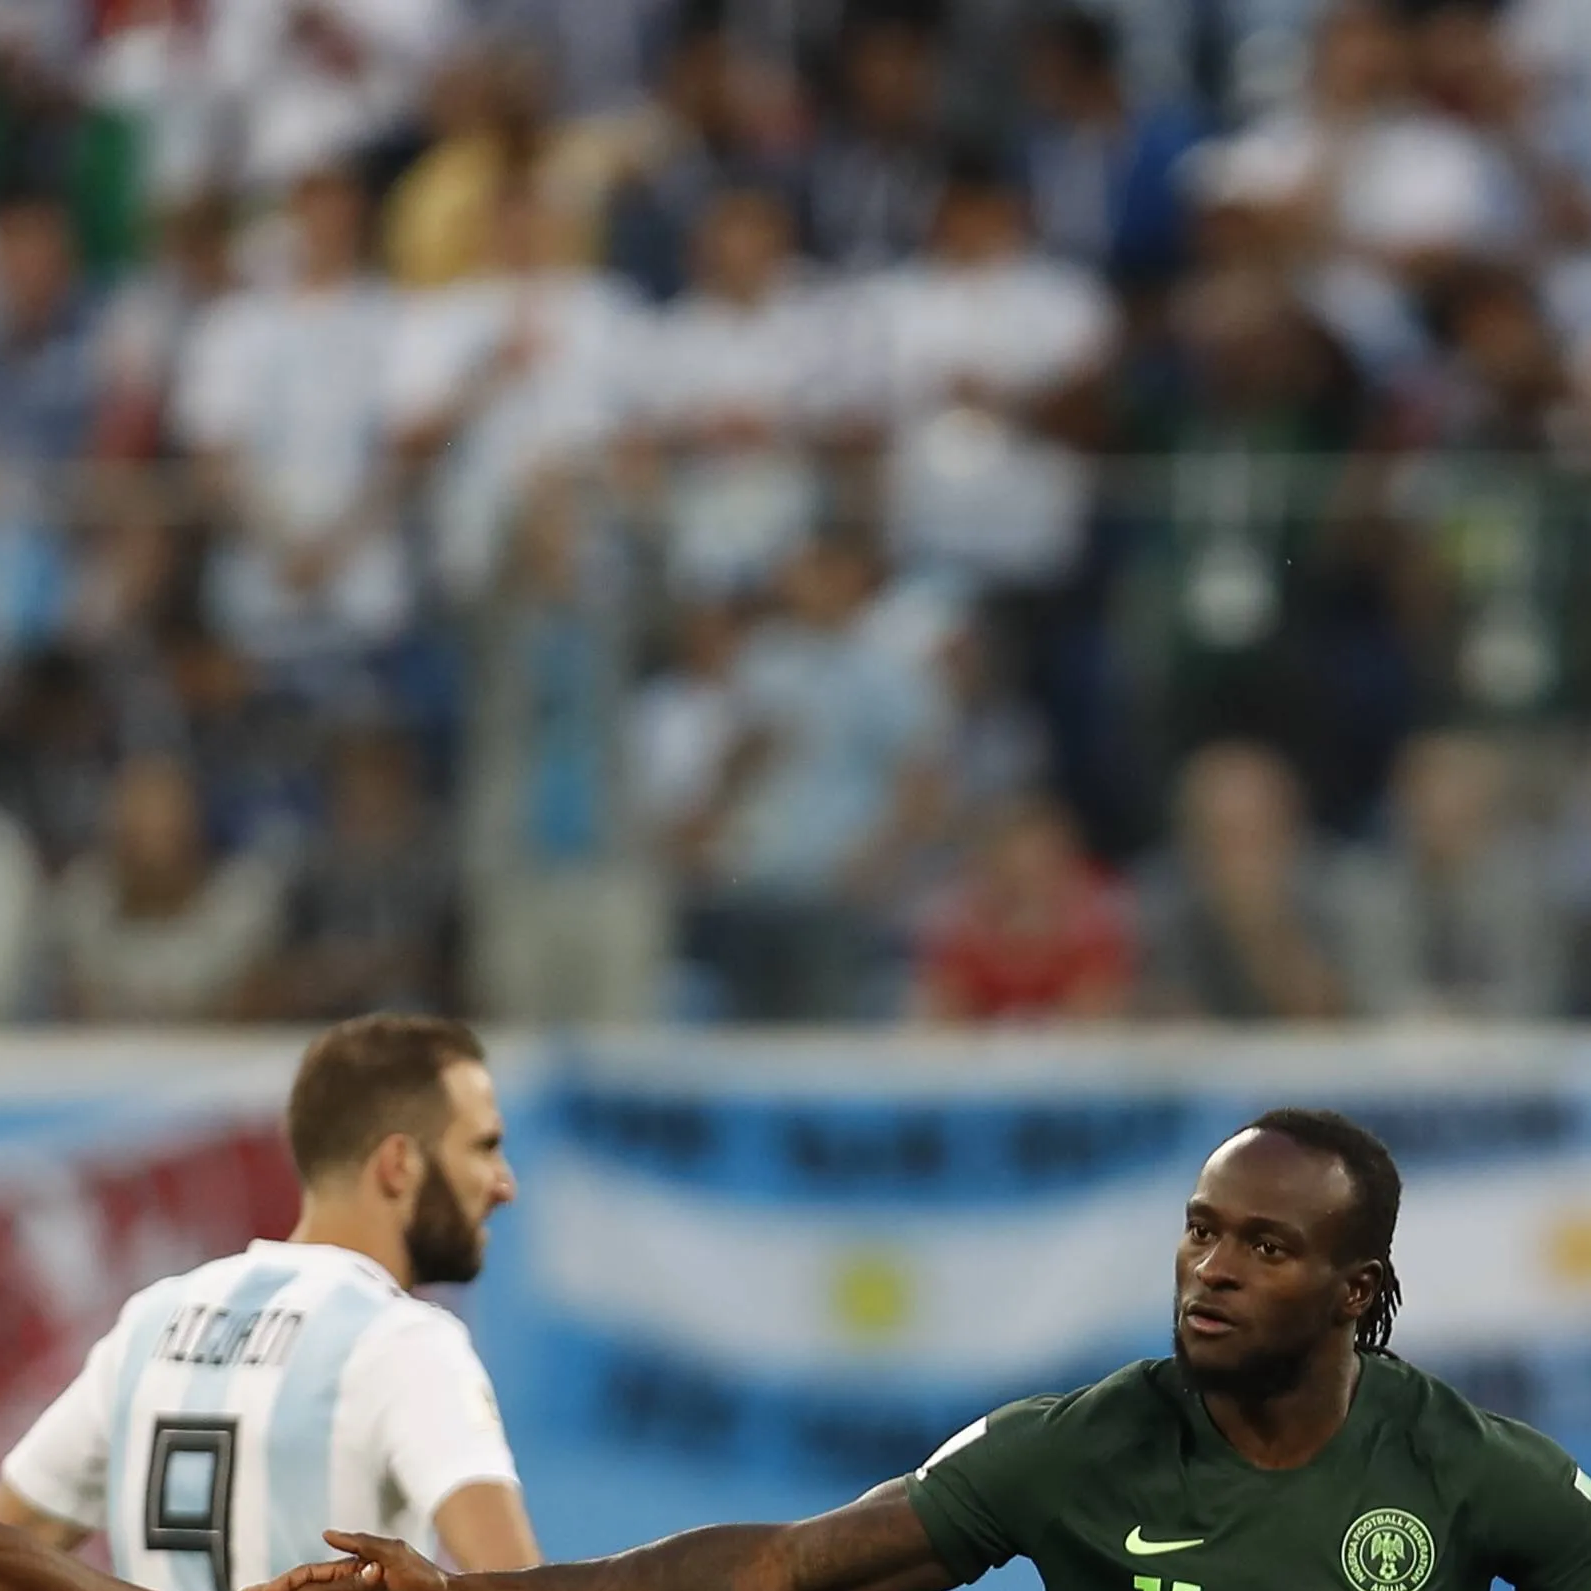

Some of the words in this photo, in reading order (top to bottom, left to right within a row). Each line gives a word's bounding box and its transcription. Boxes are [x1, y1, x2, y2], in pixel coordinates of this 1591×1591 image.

[1352, 1514, 1404, 1541] FOOTBALL
[1348, 1541, 1367, 1584] NIGERIA
[1404, 1520, 1429, 1584] FEDERATION
